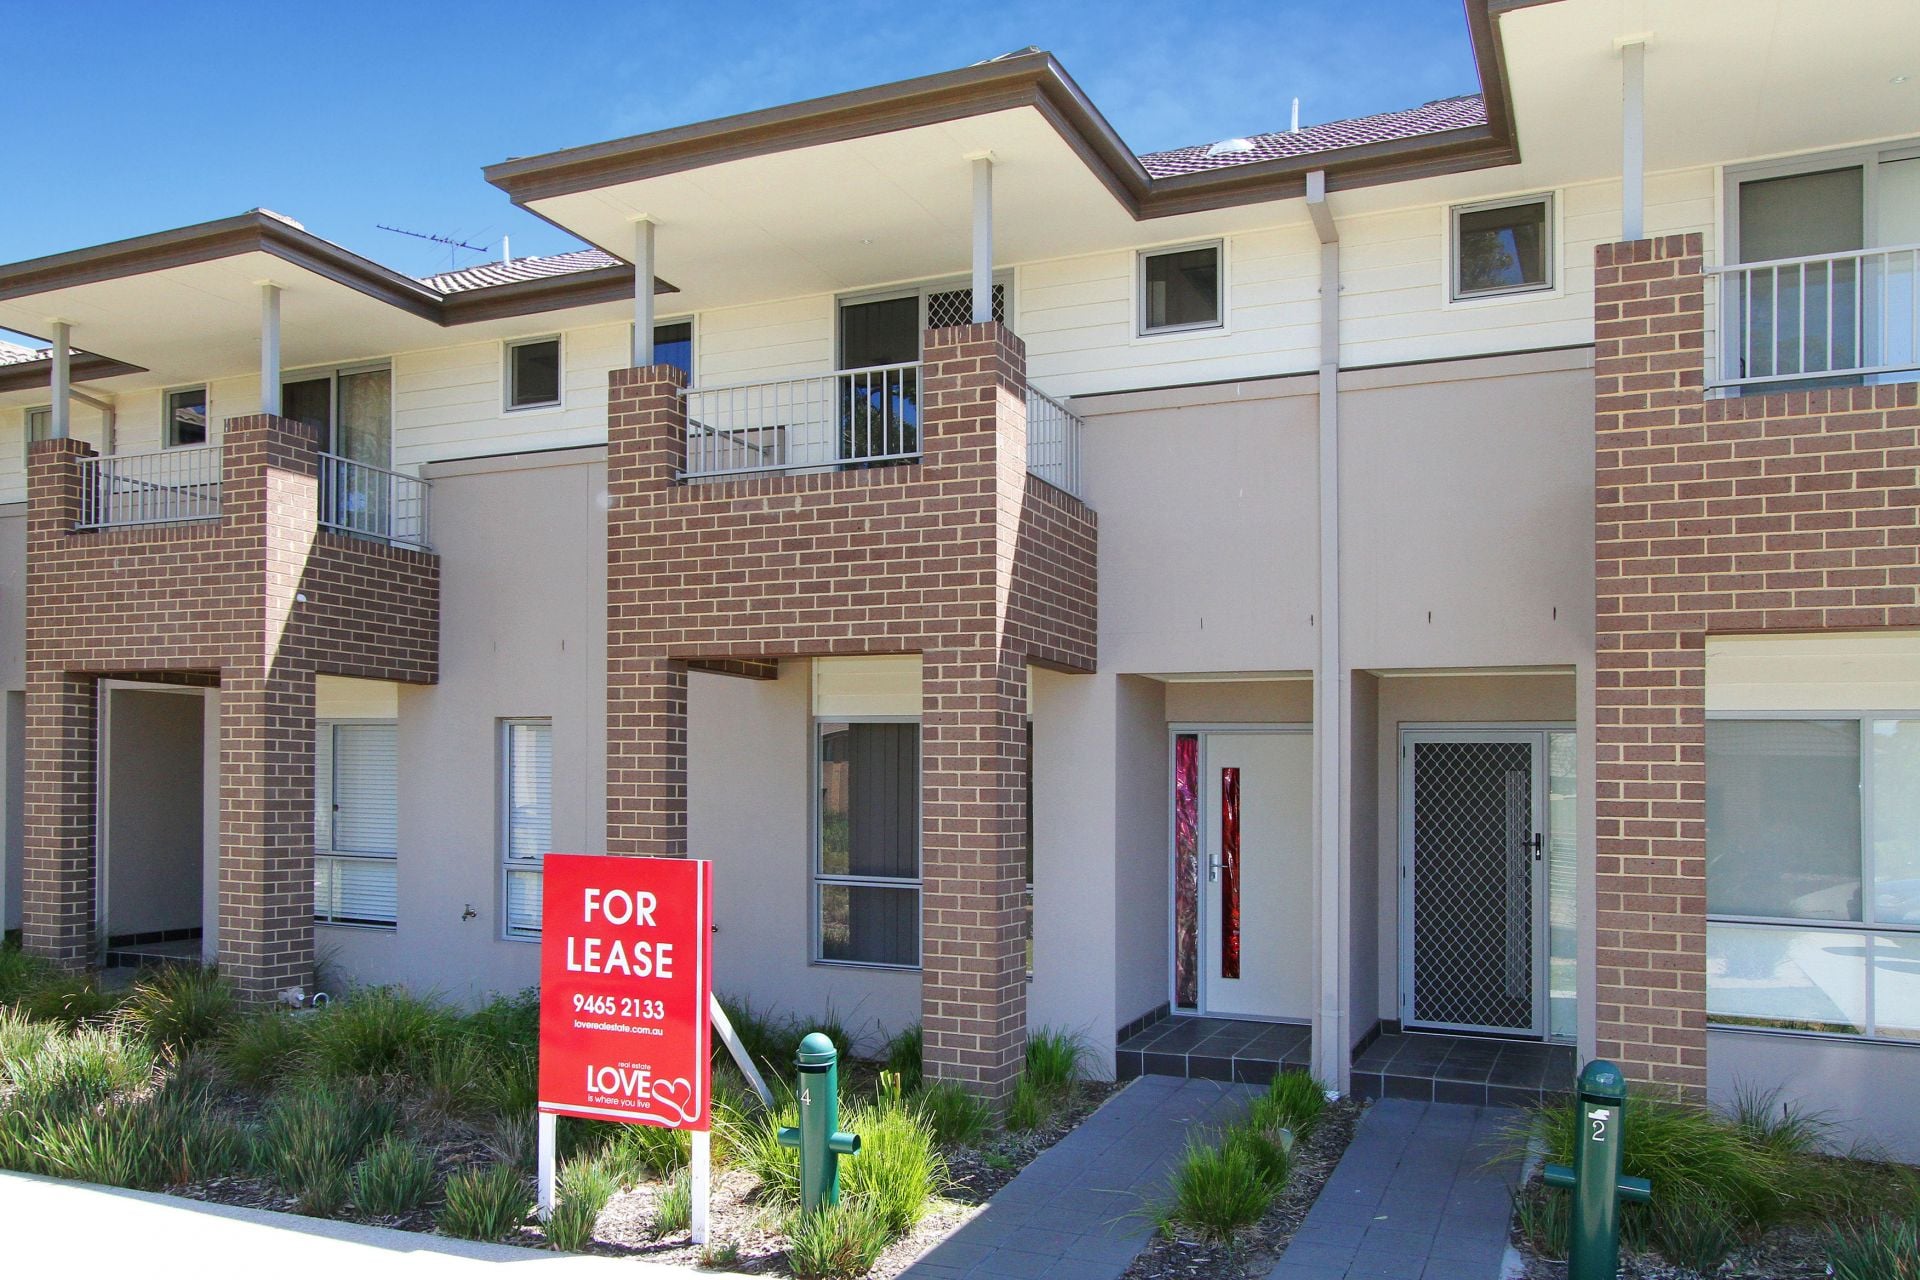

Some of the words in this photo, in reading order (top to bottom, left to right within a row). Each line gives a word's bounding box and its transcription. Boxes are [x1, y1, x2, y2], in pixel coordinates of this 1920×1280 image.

[584, 887, 657, 927] FOR
[567, 936, 673, 979] LEASE
[573, 993, 616, 1016] 9465
[621, 997, 665, 1020] 2133
[574, 1019, 663, 1036] loverealestate.com.au
[618, 1061, 631, 1069] real
[632, 1062, 652, 1071] estate
[587, 1064, 651, 1099] LOVE
[588, 1094, 594, 1103] is
[595, 1095, 619, 1105] where
[620, 1098, 636, 1108] you
[637, 1099, 651, 1109] live
[800, 1088, 811, 1105] 4
[1592, 1120, 1604, 1141] 2
